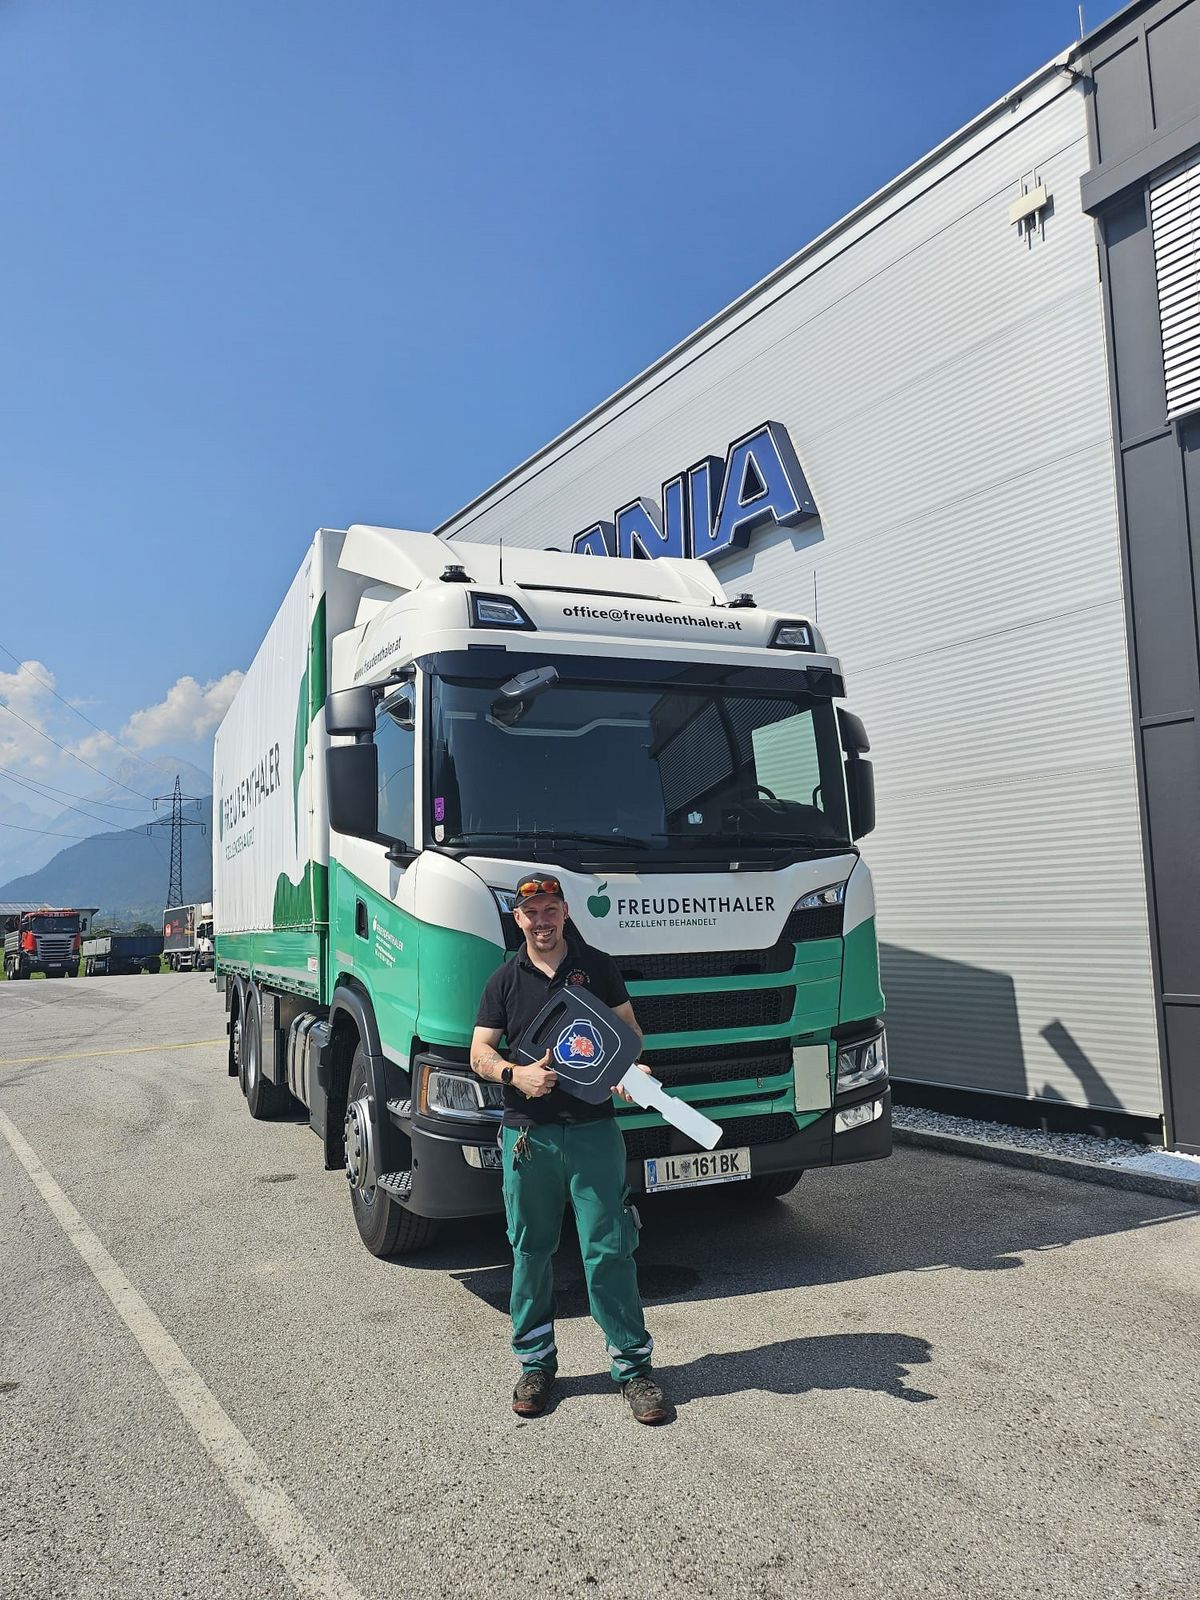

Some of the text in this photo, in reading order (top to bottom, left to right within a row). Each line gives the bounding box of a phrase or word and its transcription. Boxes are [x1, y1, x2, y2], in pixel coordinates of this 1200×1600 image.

[562, 605, 743, 631] office@freudenthaler.at
[224, 742, 280, 831] FREUDENTHALER
[617, 896, 776, 915] FREUDENTHALER
[619, 918, 717, 928] EXZELLENT BEHANDELT
[665, 1161, 680, 1181] IL
